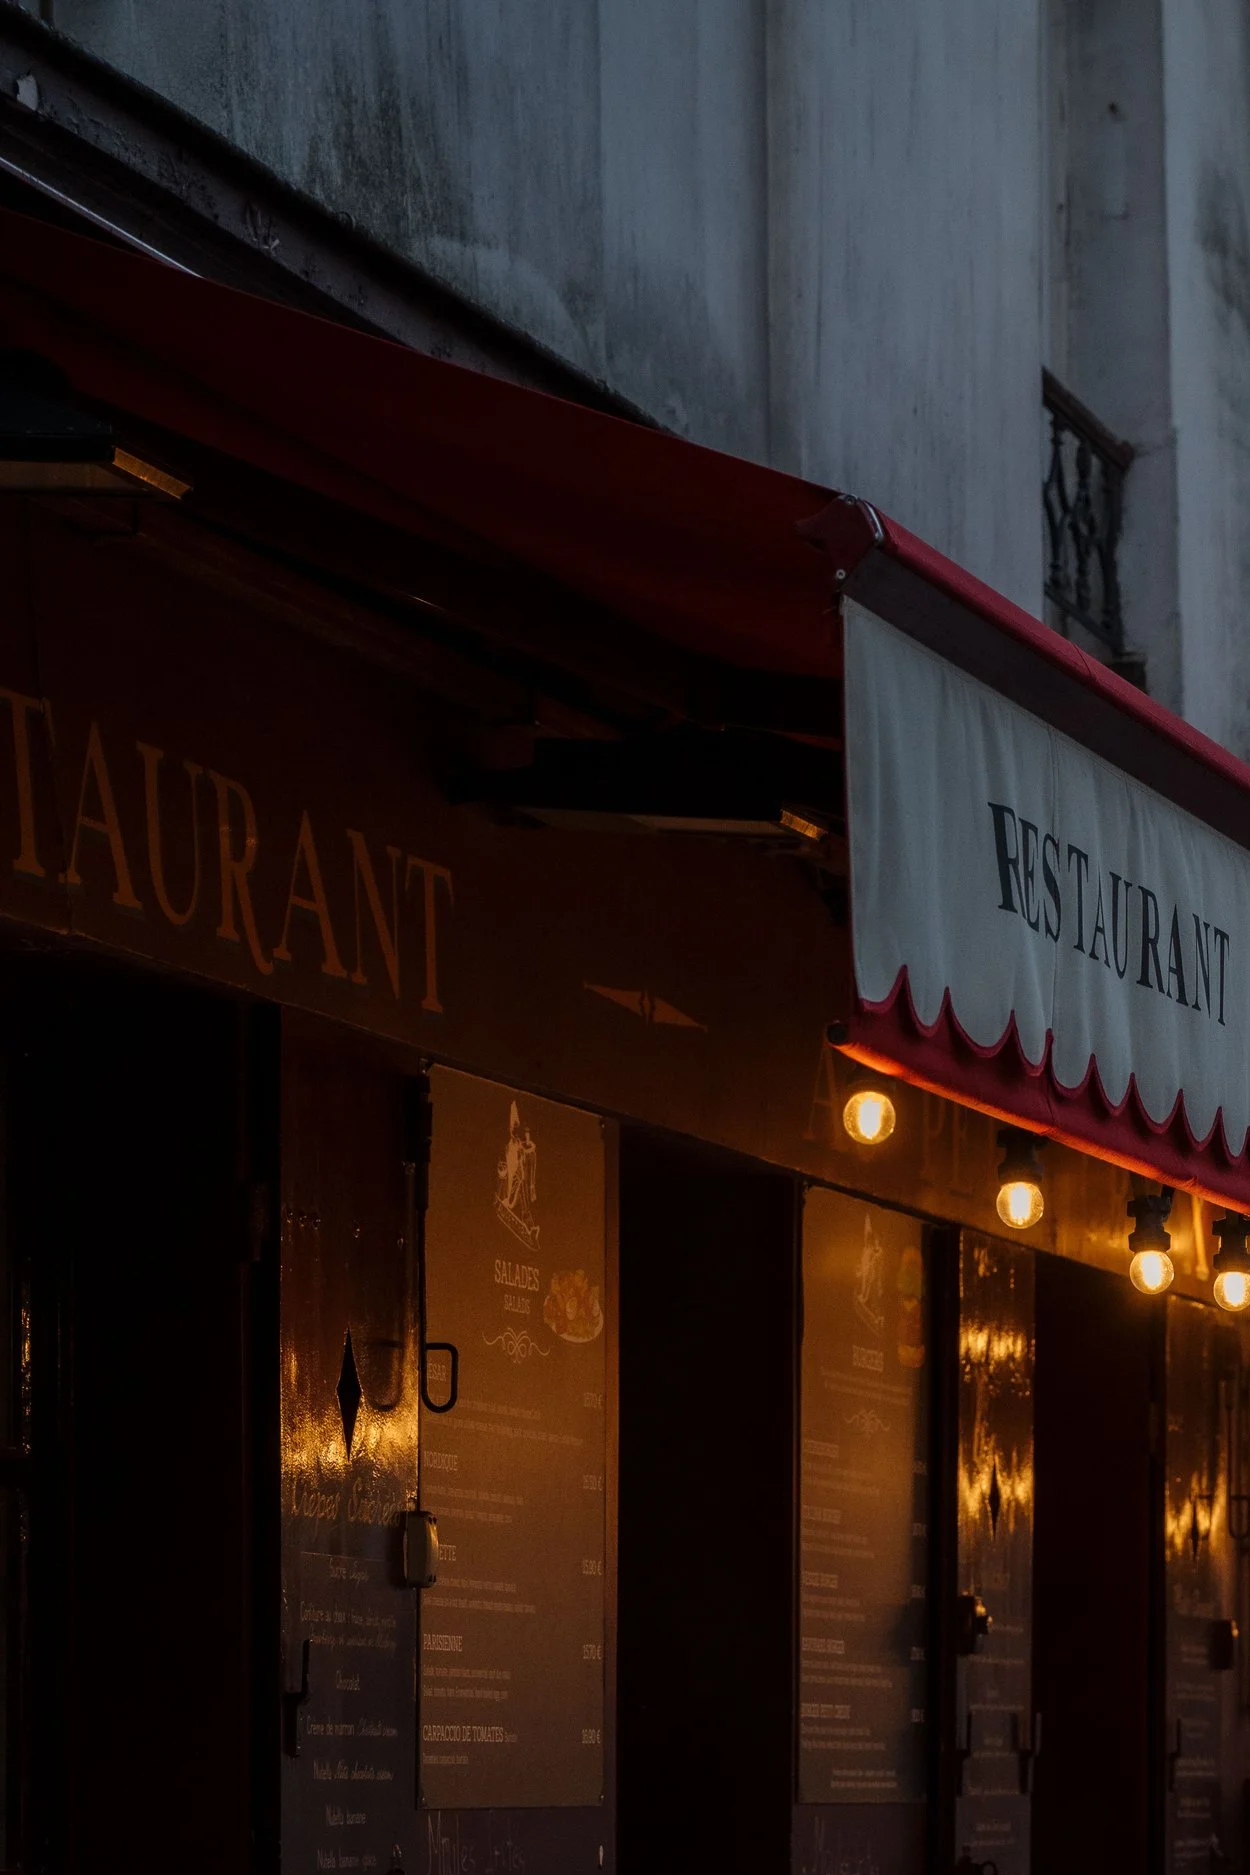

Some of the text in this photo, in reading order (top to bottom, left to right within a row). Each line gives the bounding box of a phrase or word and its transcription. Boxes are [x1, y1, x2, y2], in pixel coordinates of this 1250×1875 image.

[2, 684, 456, 1014] TAURANT
[987, 801, 1230, 1026] RESTAURANT
[494, 1258, 540, 1292] SALADES
[423, 1633, 463, 1653] PARISIENNE
[422, 1725, 460, 1742] CARPACCIO
[461, 1725, 471, 1742] DE
[472, 1725, 504, 1743] TOMATES
